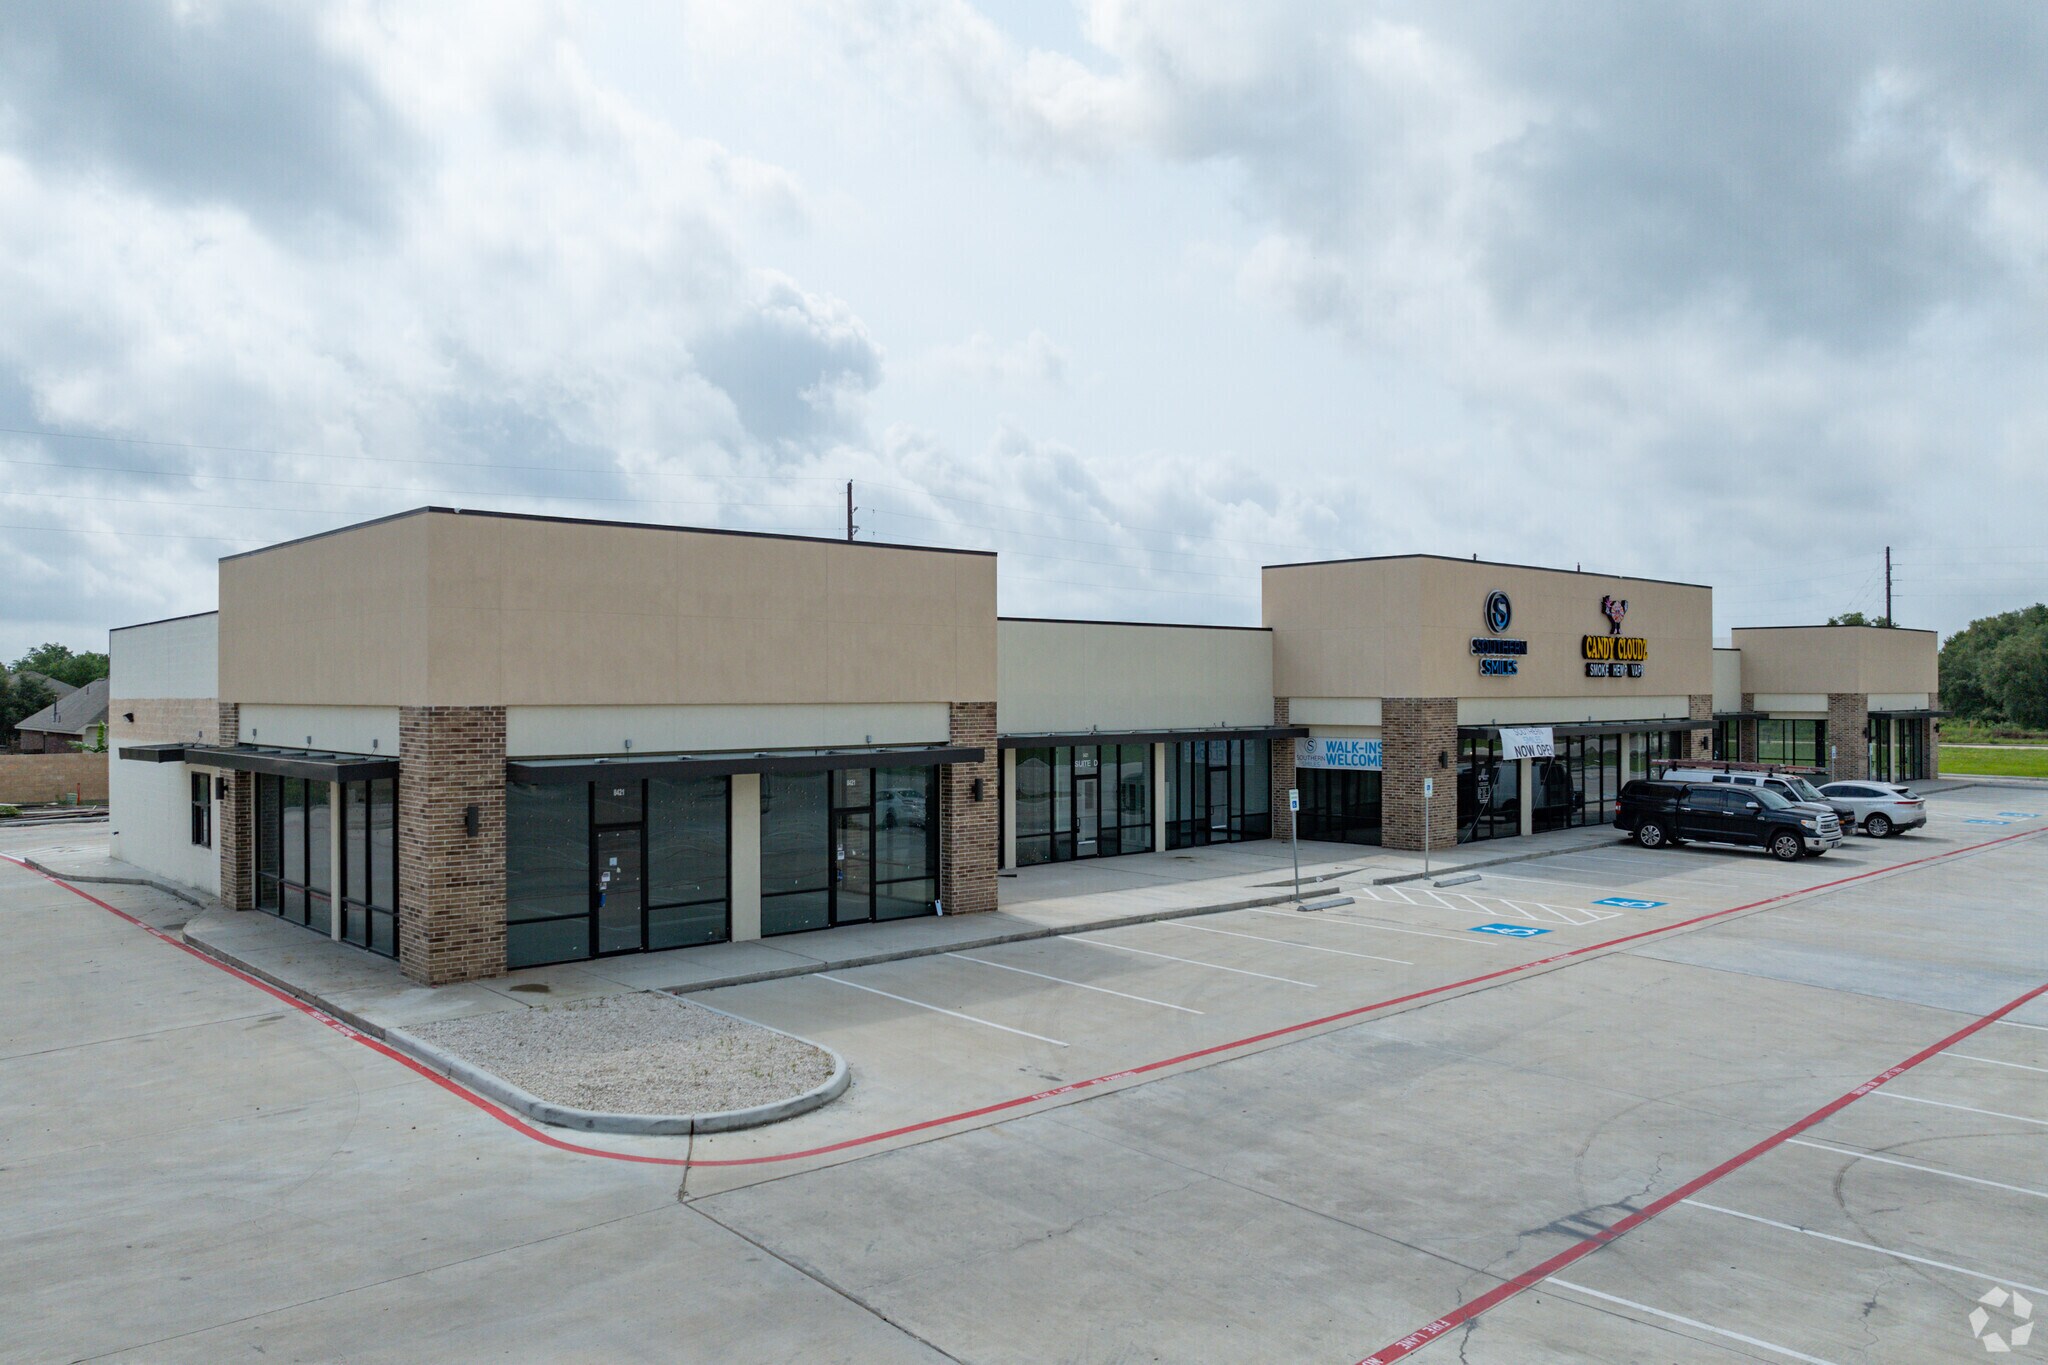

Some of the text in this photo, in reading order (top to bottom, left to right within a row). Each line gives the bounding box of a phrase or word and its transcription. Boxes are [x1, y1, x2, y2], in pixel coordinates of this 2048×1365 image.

[1472, 639, 1528, 655] SOUTHERN
[1585, 636, 1648, 660] CANDY CLOUDZ
[1481, 659, 1518, 675] SMILES
[1589, 664, 1610, 677] SMOKE
[1296, 754, 1326, 762] SOUTHERN
[1514, 745, 1536, 758] NOW
[1075, 759, 1099, 768] SUITE D
[1422, 1319, 1450, 1335] FIRE
[1395, 1332, 1428, 1350] LANE
